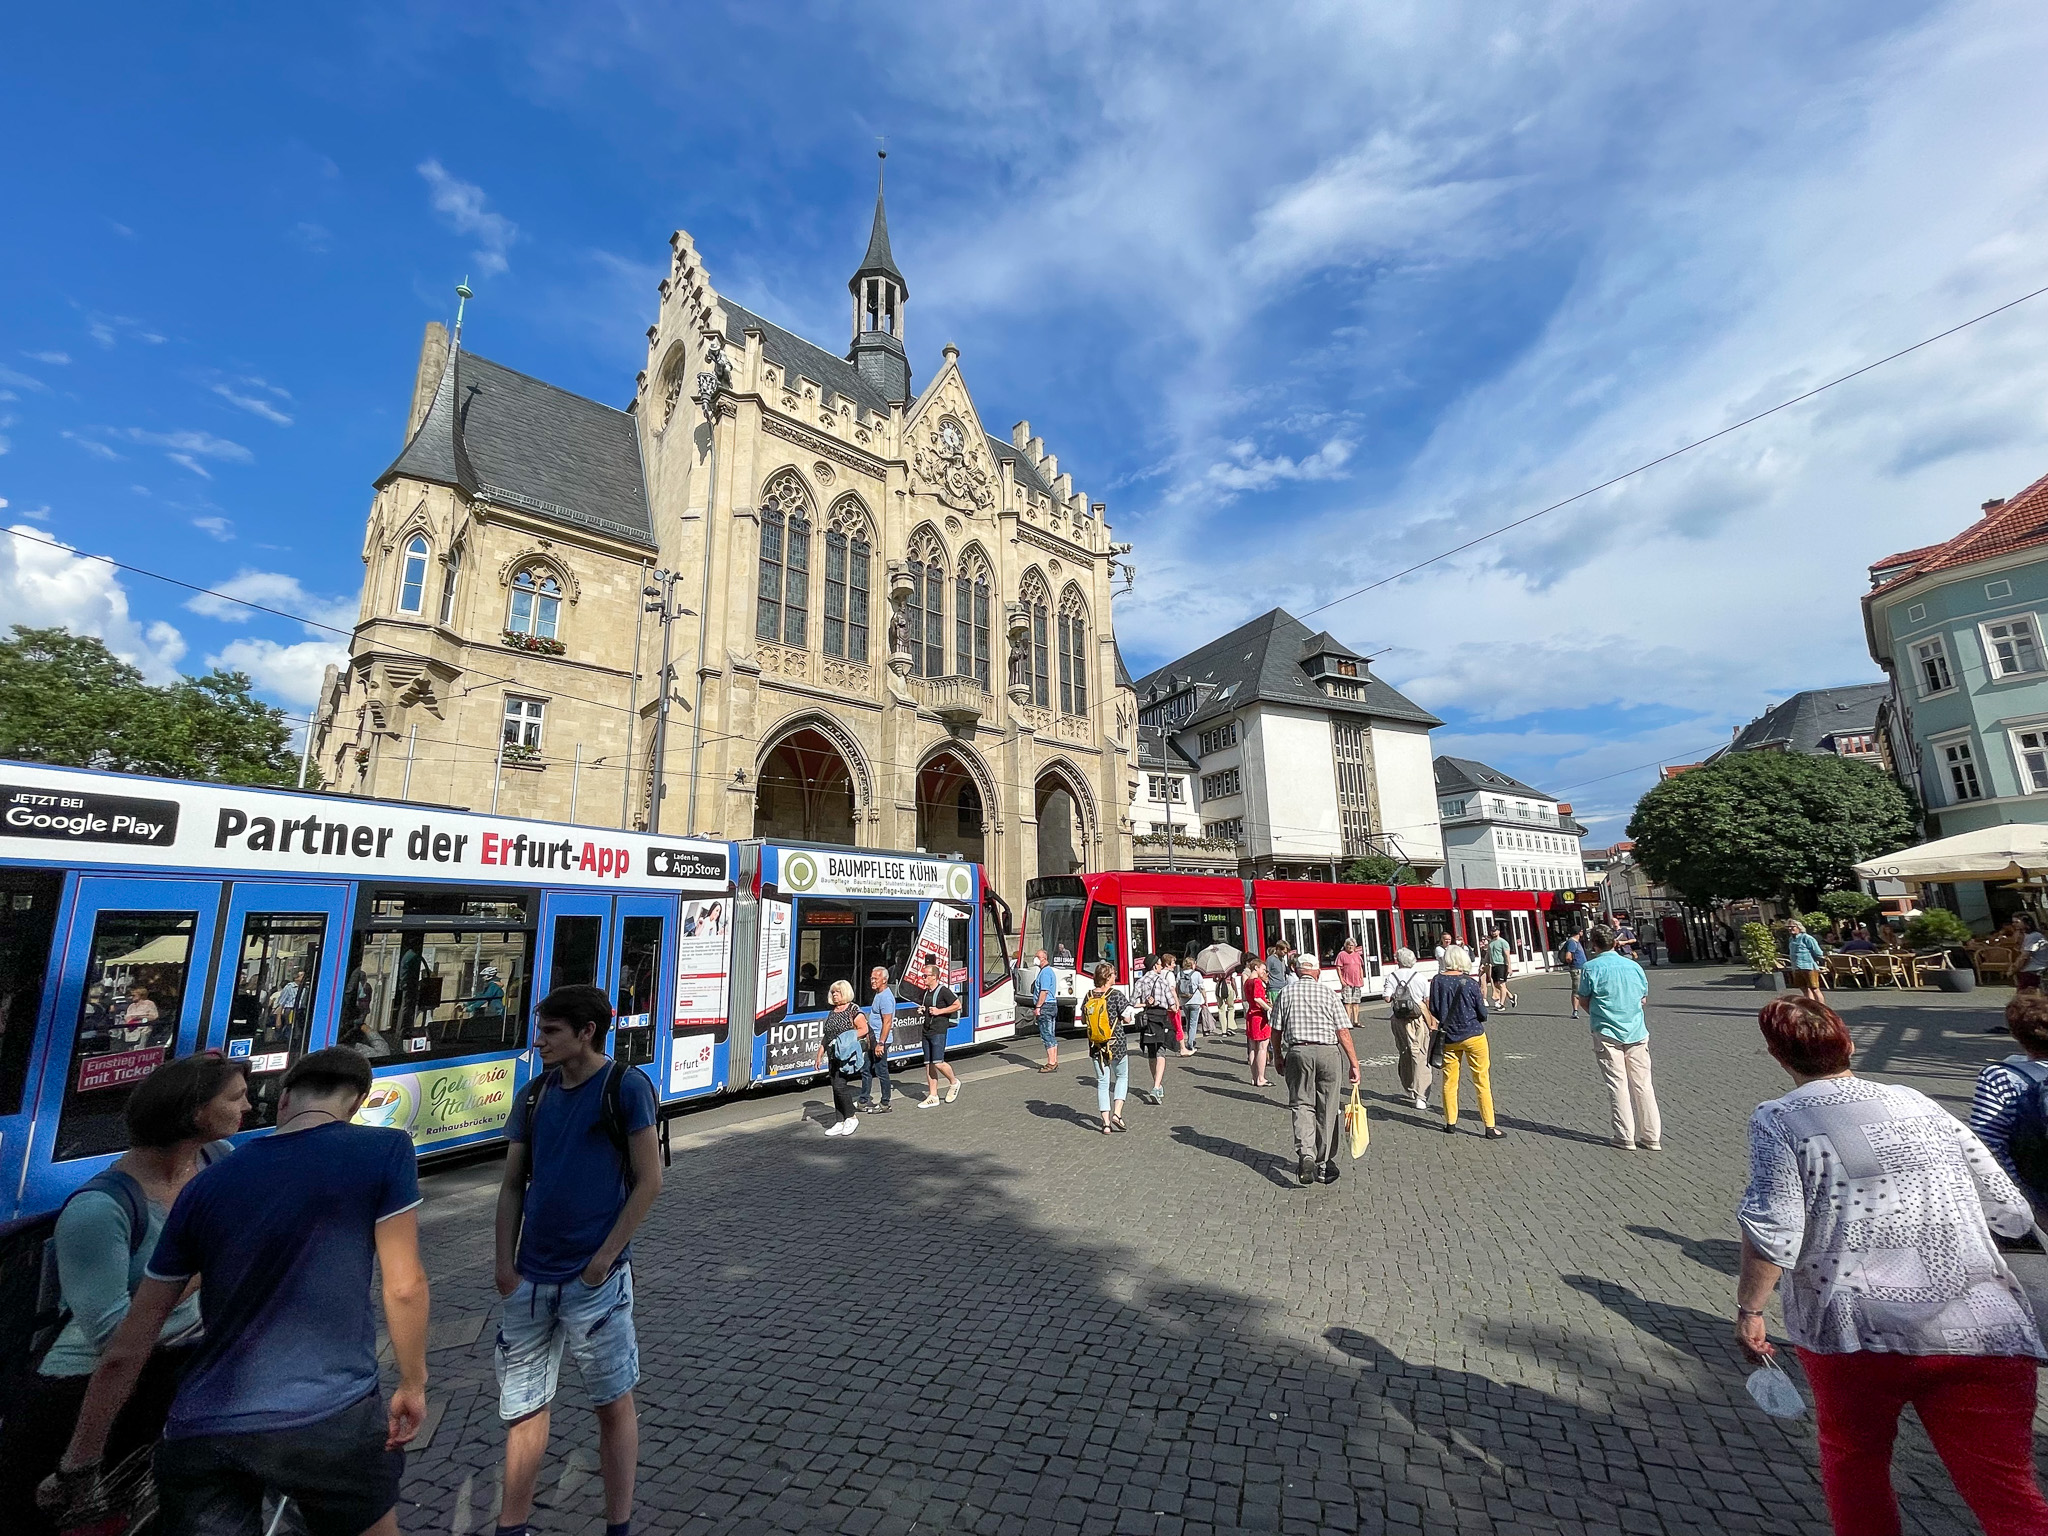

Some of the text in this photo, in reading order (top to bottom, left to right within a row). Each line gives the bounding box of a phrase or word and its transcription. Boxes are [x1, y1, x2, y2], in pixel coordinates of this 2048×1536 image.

[10, 793, 84, 809] JETZT BEI
[5, 807, 164, 840] Google Play
[214, 808, 630, 878] Partner der Erfurt-App
[673, 853, 691, 862] Laden
[673, 864, 720, 877] App Store
[829, 858, 938, 882] BAUMPFLEGE KÜHN
[845, 885, 925, 896] www.baumpflege-kuehn.de
[1203, 913, 1208, 922] 3
[770, 1021, 825, 1044] HOTEL
[87, 1051, 160, 1072] Einstieg nur
[675, 1059, 698, 1071] Erfurt
[84, 1062, 158, 1086] mit Ticket
[430, 1067, 508, 1106] Gelateria
[431, 1090, 505, 1122] Italiana
[426, 1115, 493, 1136] Rathausbrücke
[496, 1112, 506, 1121] 10
